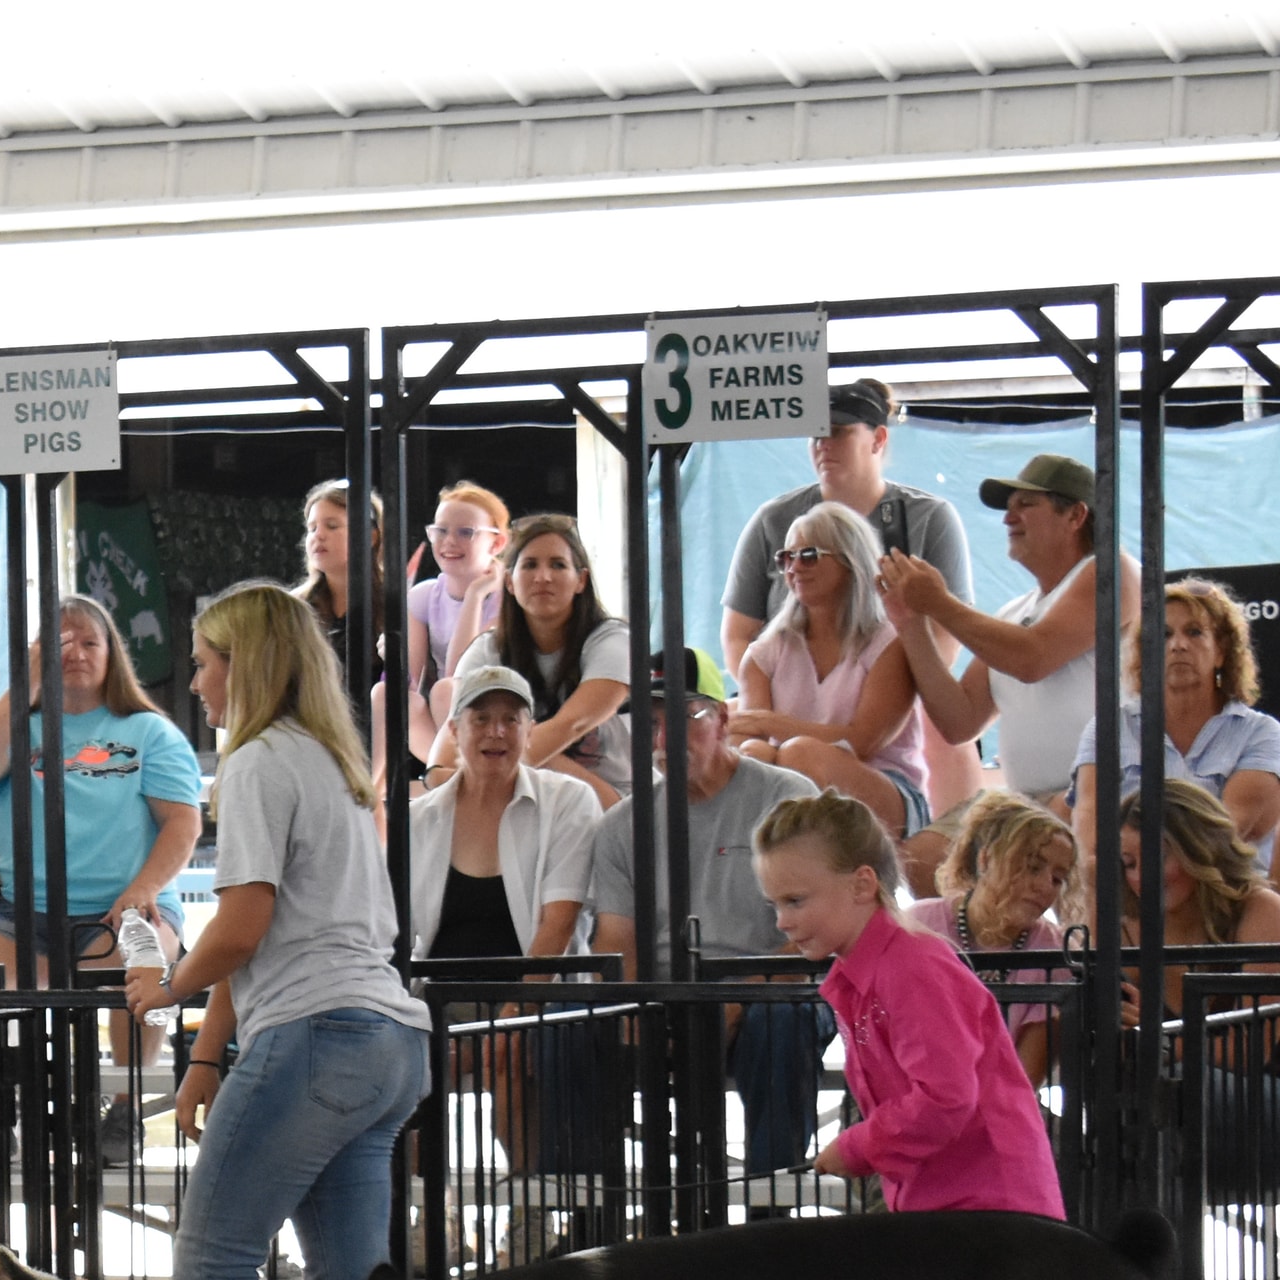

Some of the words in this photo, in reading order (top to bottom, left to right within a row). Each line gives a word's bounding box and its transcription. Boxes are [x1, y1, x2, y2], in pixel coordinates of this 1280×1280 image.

[692, 330, 821, 357] OAKVEIW
[653, 332, 693, 430] 3
[708, 363, 804, 389] FARMS
[14, 399, 89, 423] SHOW
[710, 396, 804, 422] MEATS
[23, 431, 82, 454] PIGS
